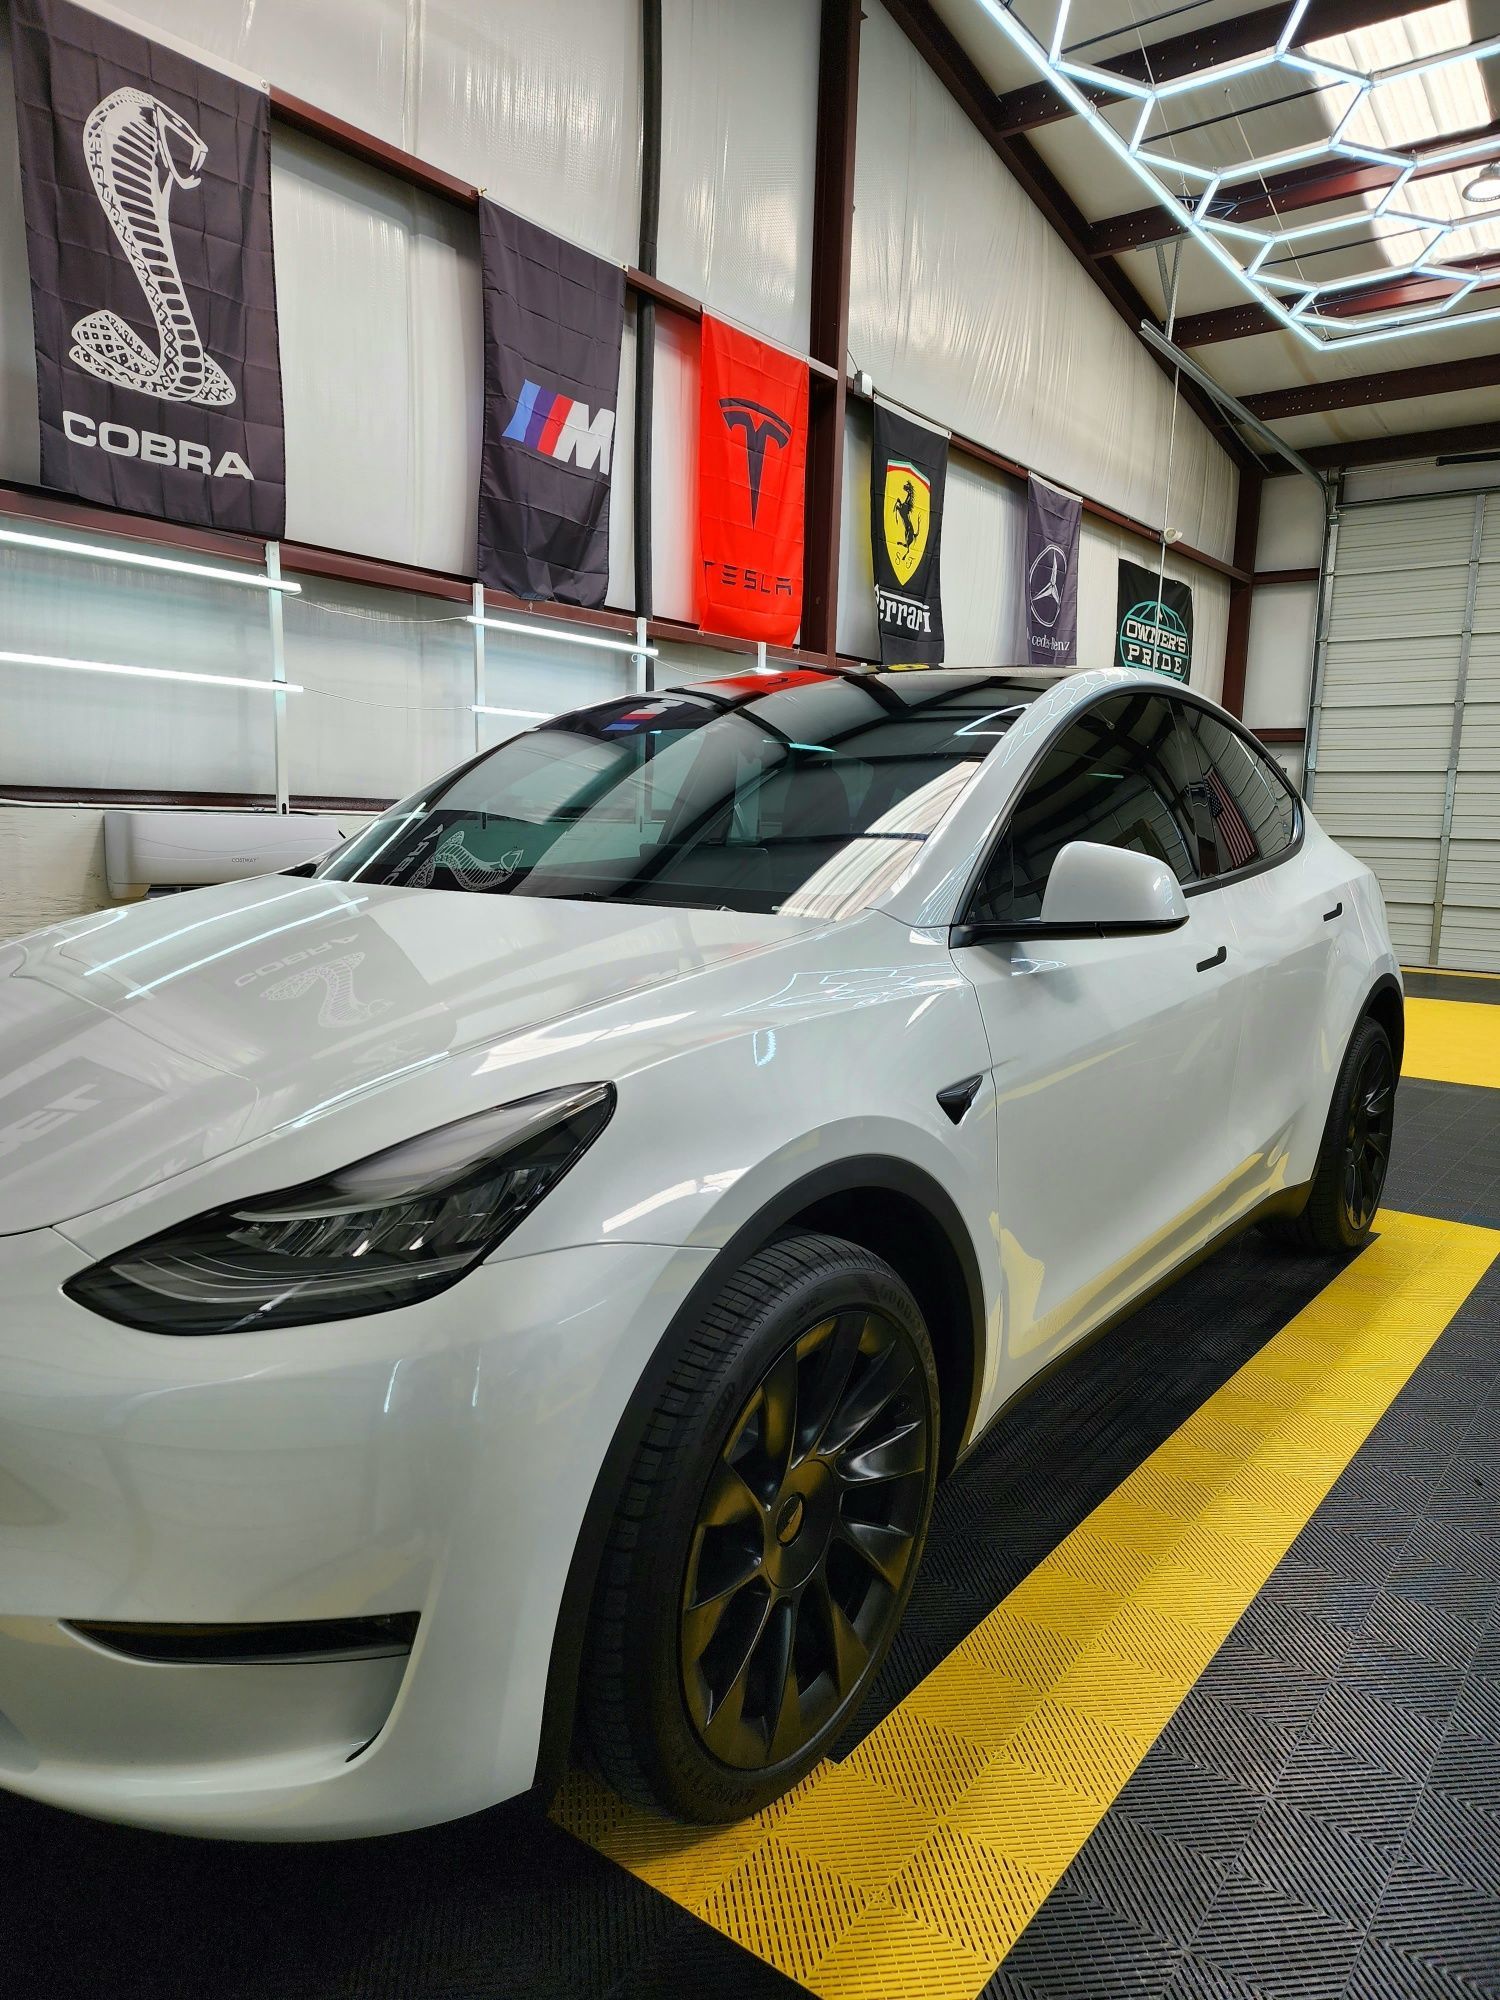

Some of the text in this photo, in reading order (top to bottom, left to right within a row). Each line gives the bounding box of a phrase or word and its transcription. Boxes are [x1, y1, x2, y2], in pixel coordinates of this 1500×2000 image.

[62, 410, 255, 481] COBRA
[1126, 619, 1187, 654] OWNER'S
[1127, 643, 1182, 674] PRIDE
